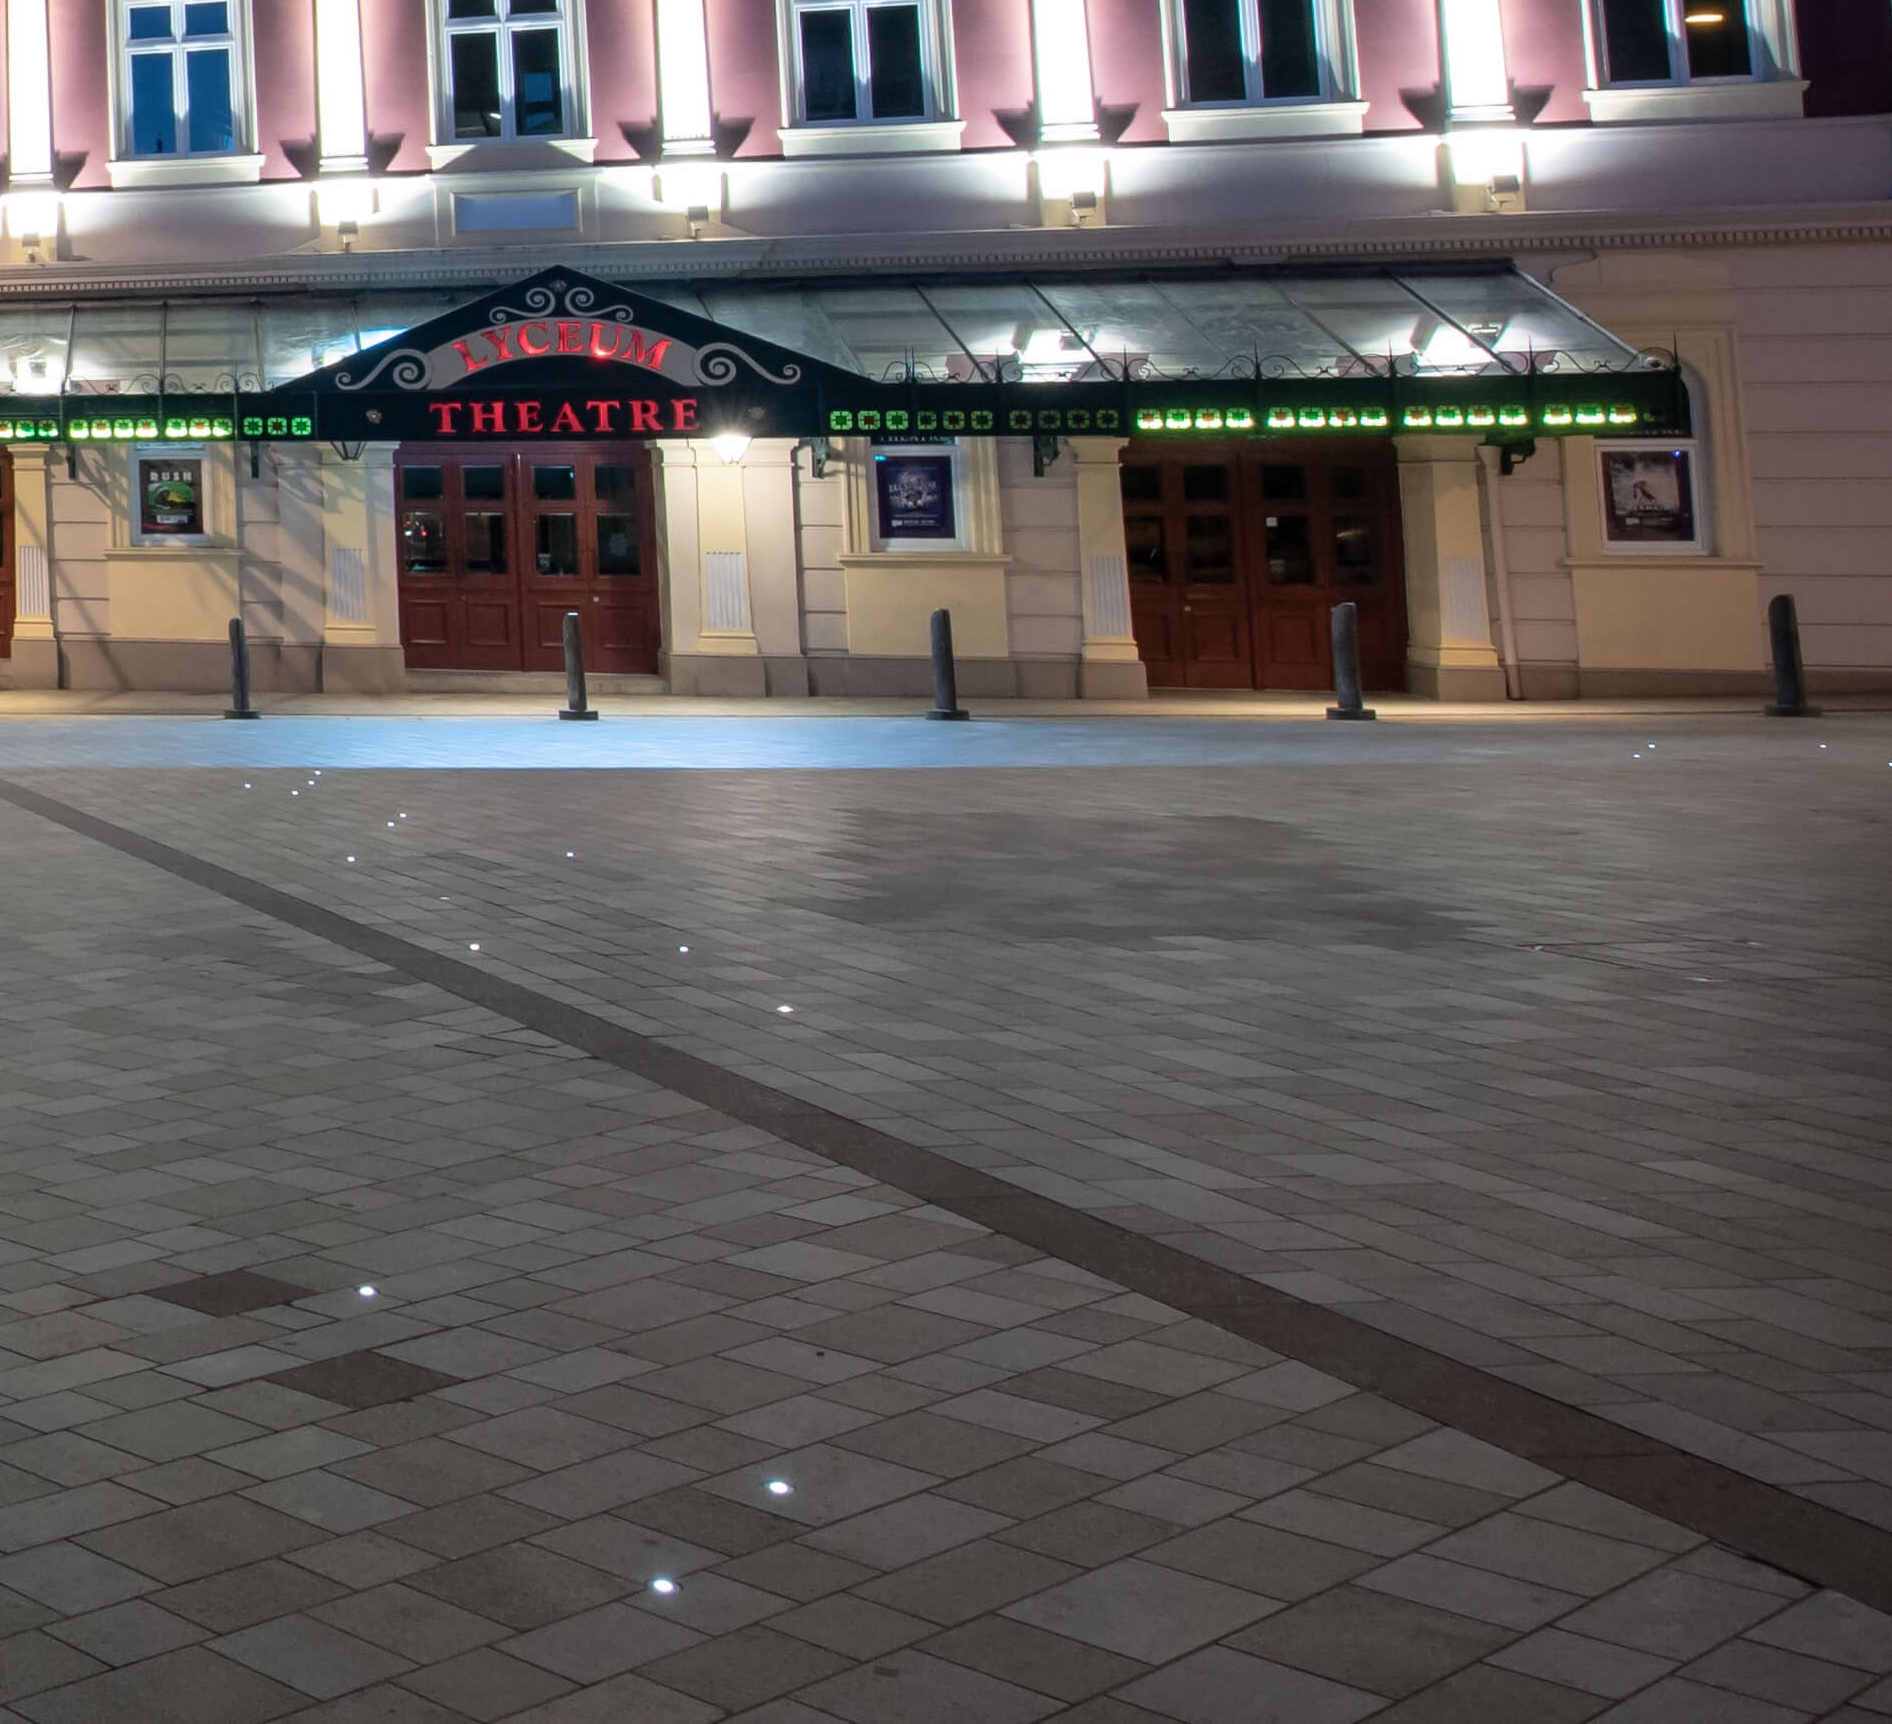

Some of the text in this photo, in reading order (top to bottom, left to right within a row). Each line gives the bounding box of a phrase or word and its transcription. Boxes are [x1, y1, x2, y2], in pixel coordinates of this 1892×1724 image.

[452, 320, 673, 373] LYCEUM
[428, 398, 700, 434] THEATRE
[149, 470, 193, 482] RUSH
